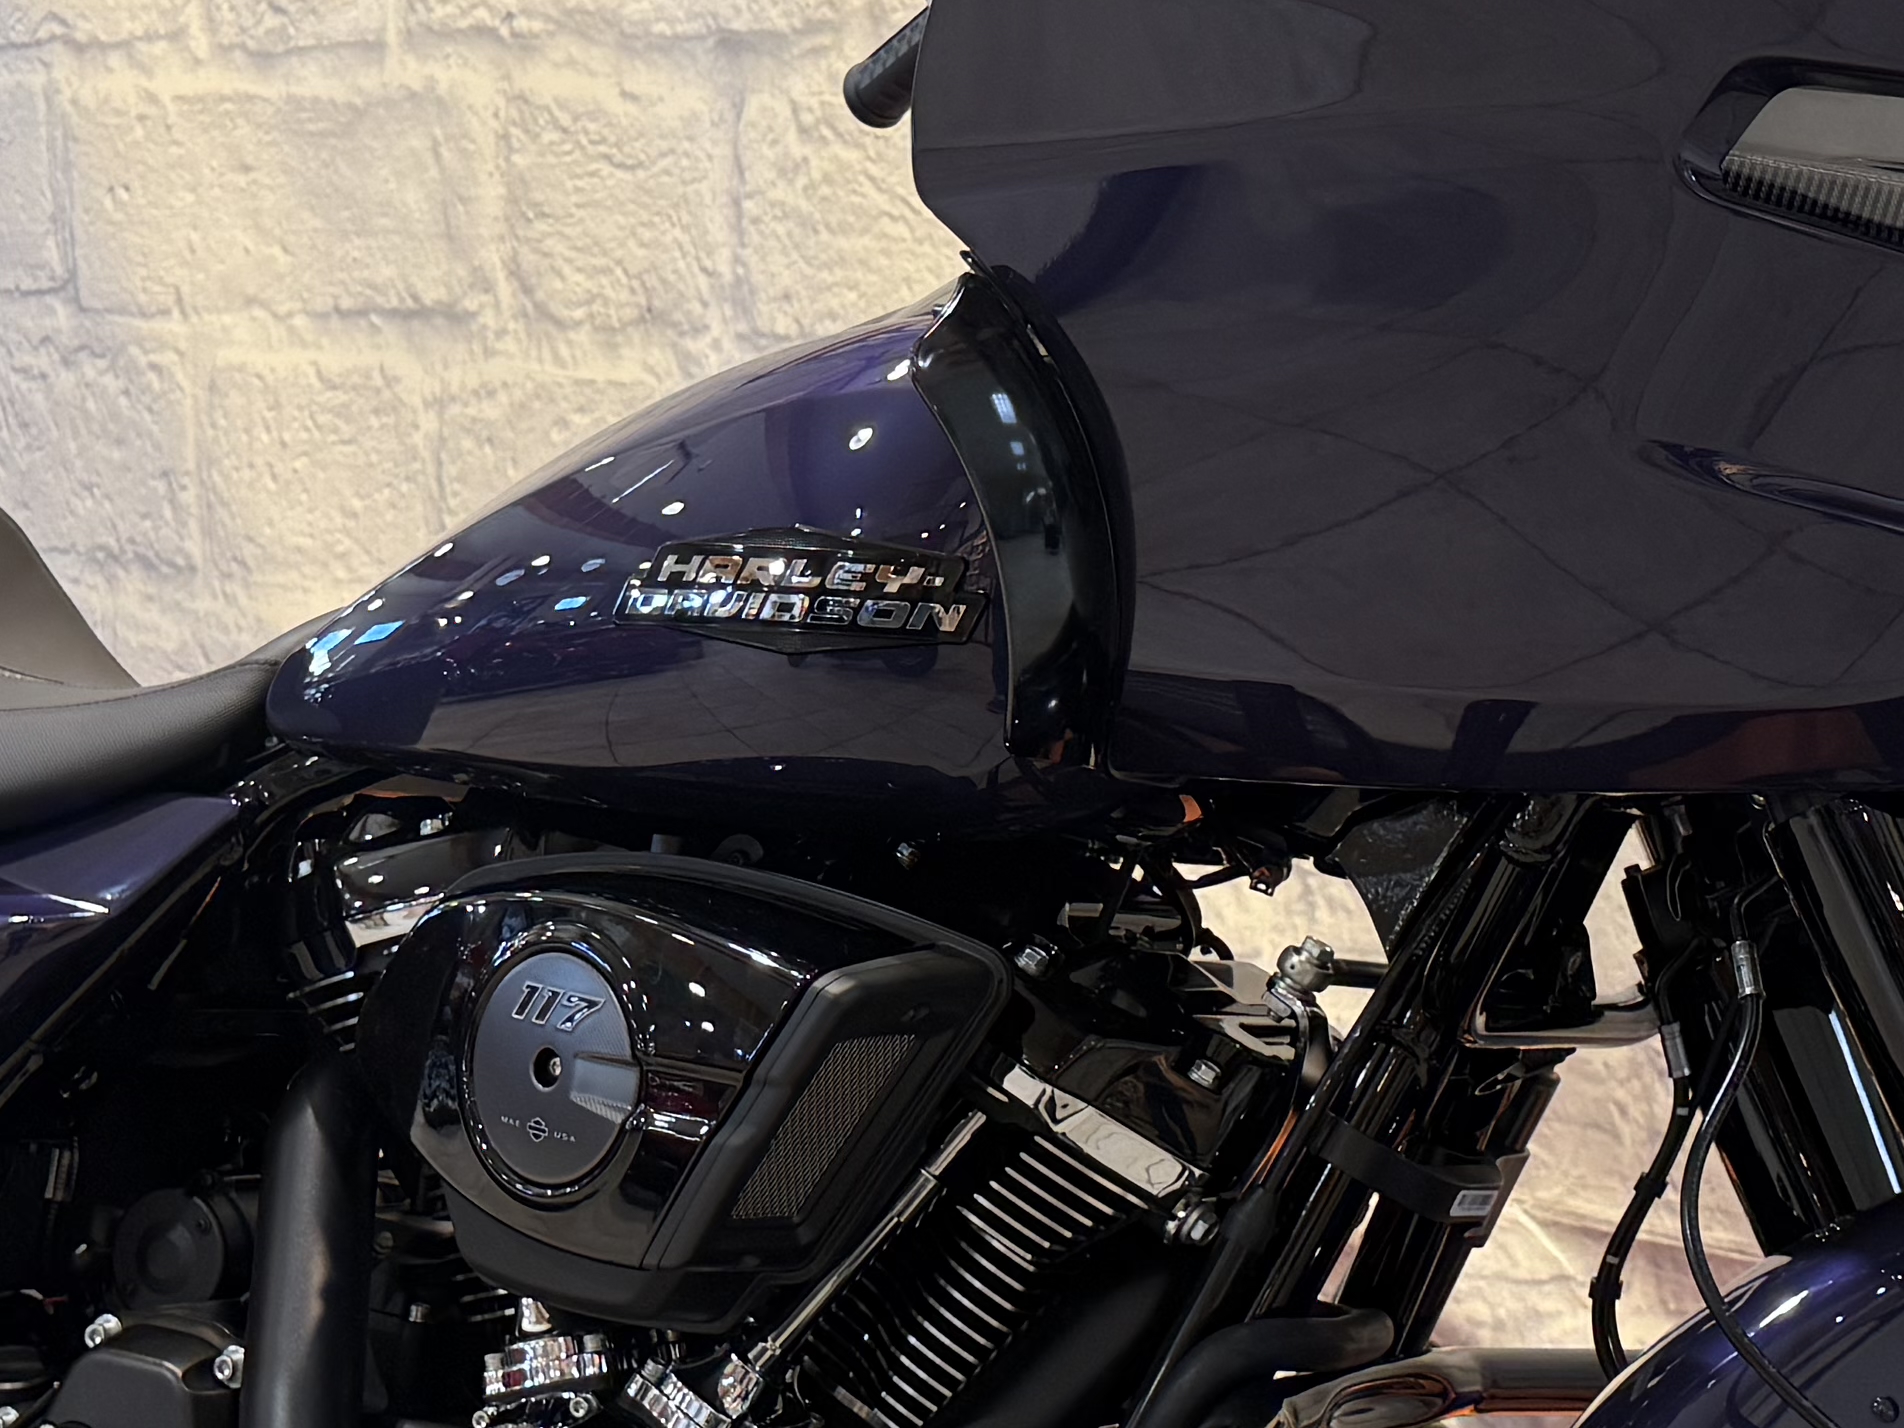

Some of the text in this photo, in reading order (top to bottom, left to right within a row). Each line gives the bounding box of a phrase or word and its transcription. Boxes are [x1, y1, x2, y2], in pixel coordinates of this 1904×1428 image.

[657, 554, 945, 593] HARLEY-
[625, 590, 967, 631] DAVIDSON
[511, 980, 606, 1032] 117
[554, 1131, 576, 1143] USA
